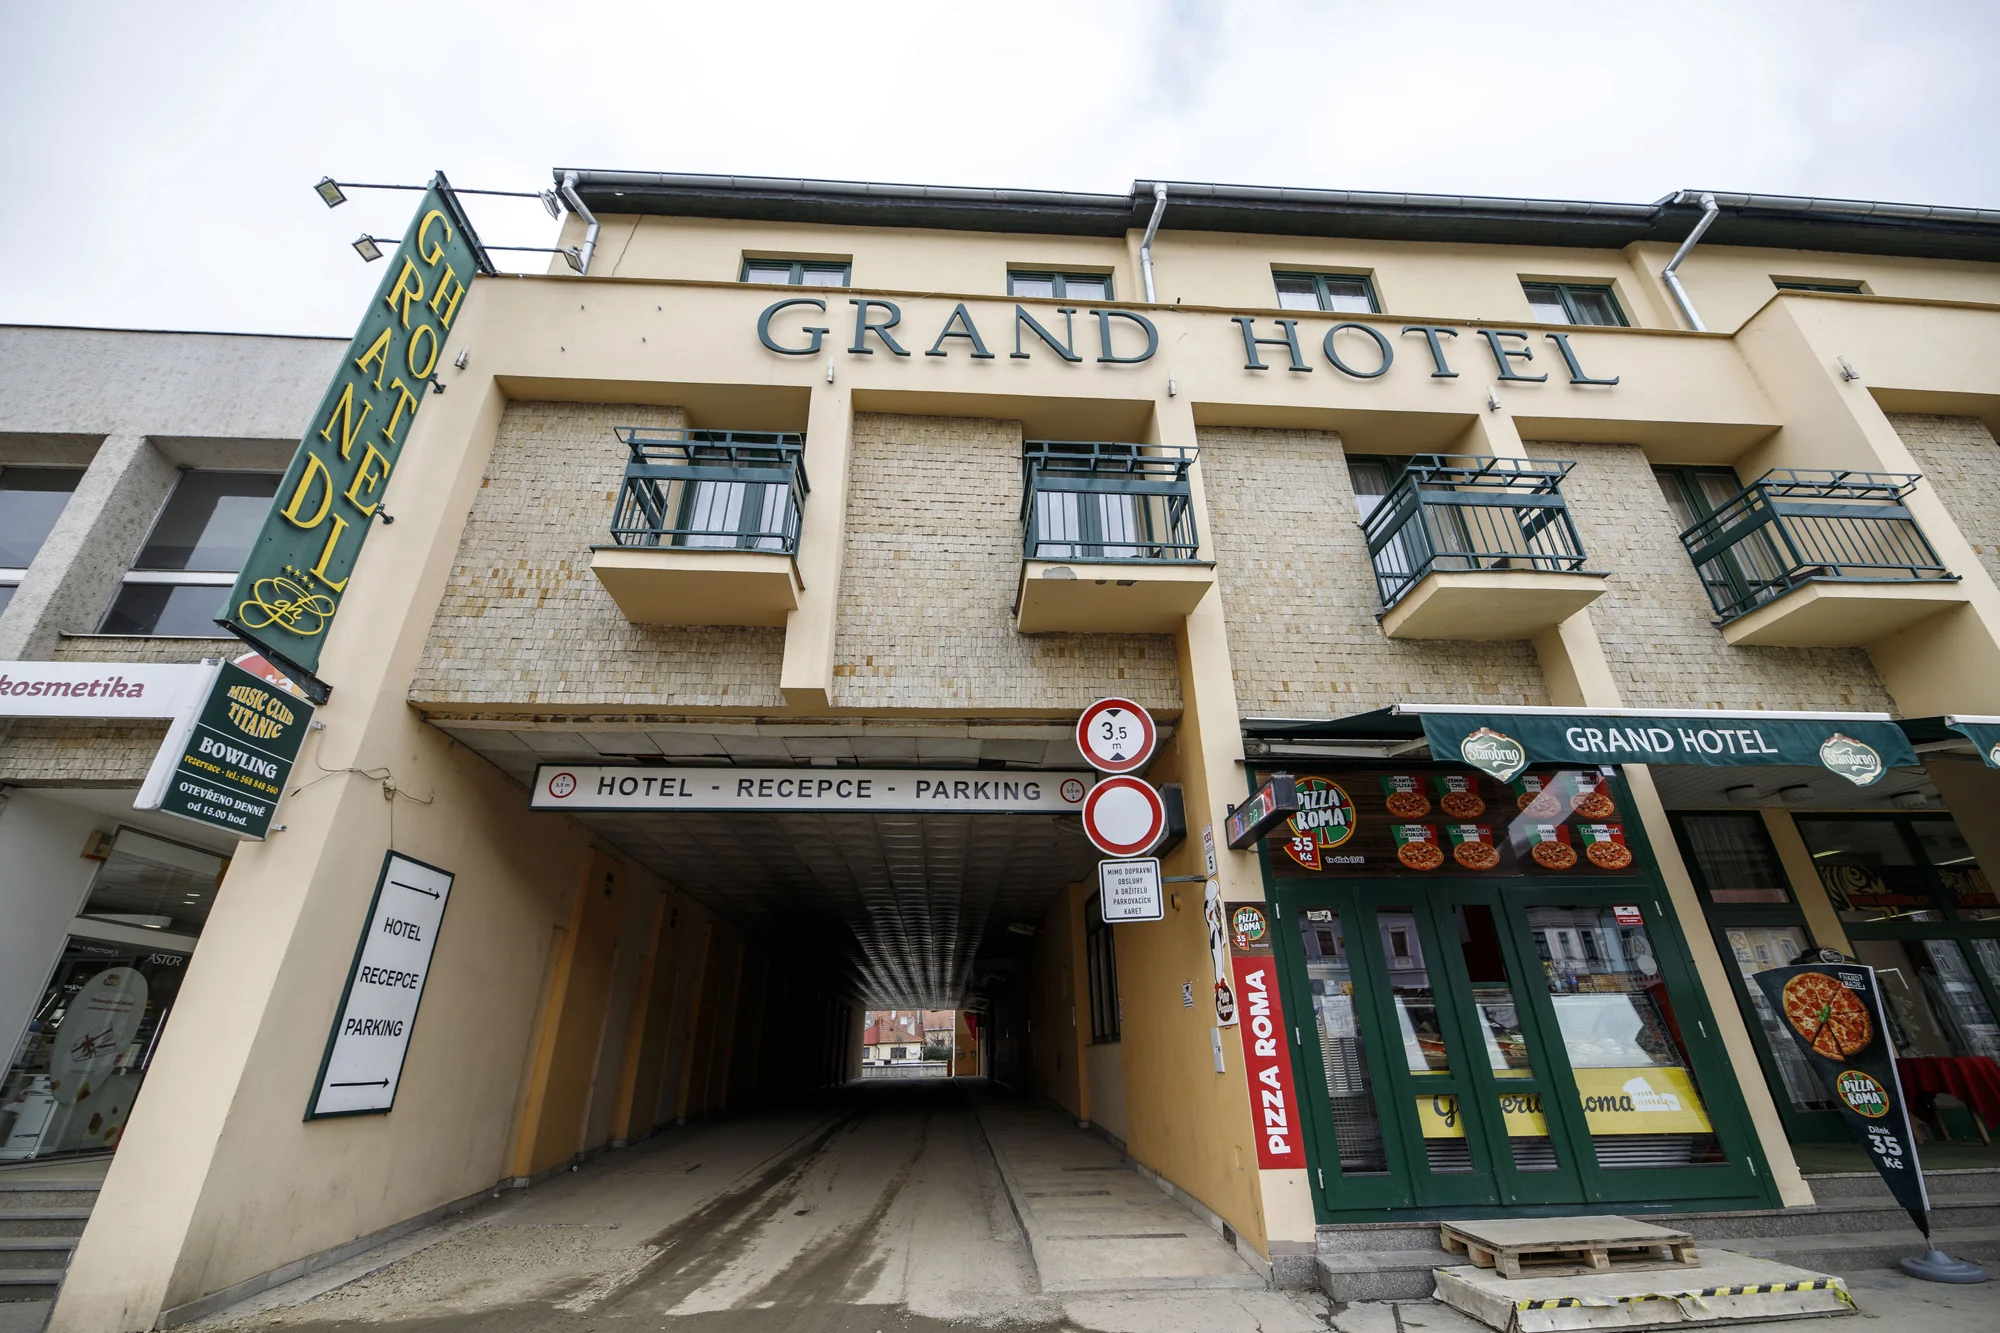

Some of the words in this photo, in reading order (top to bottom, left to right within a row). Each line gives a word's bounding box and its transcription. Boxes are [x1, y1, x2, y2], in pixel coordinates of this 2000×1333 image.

[757, 297, 1160, 364] GRAND
[1231, 317, 1620, 386] HOTEL
[281, 209, 454, 529] GRAND
[310, 262, 466, 593] HOTEL
[0, 674, 145, 698] kosmetika
[227, 686, 269, 711] MUSIC
[266, 698, 294, 726] CLUB
[228, 701, 284, 739] TITANIC
[1112, 742, 1122, 750] m
[1565, 727, 1674, 753] GRAND
[1681, 728, 1779, 754] HOTEL
[198, 736, 279, 779] BOWLING
[184, 754, 221, 774] rezervace
[240, 774, 253, 786] 568
[266, 784, 279, 795] 560
[179, 781, 233, 806] OTEVŘENO
[233, 799, 266, 817] DENNĚ
[597, 776, 693, 797] HOTEL
[737, 778, 872, 799] RECEPCE
[915, 780, 1041, 801] PARKING
[187, 801, 202, 812] od
[203, 805, 227, 819] 15.00
[227, 812, 248, 826] hod.
[1296, 808, 1346, 831] ROMA
[1292, 837, 1314, 851] 35
[1299, 852, 1313, 861] Kč
[1107, 868, 1123, 876] MIMO
[1124, 865, 1153, 875] DOPRAVNÍ
[1117, 877, 1143, 886] OBSLUHY
[1112, 896, 1152, 906] PARKOVACÍCH
[1123, 907, 1142, 915] KARET
[383, 917, 421, 942] HOTEL
[1236, 934, 1247, 942] 35
[1239, 921, 1260, 932] ROMA
[146, 952, 183, 967] ASTOR
[360, 965, 419, 989] RECEPCE
[1245, 969, 1277, 1057] ROMA
[344, 1018, 403, 1037] PARKING
[1259, 1065, 1291, 1155] PIZZA
[1582, 1094, 1634, 1113] oma
[1847, 1092, 1882, 1105] ROMA
[1868, 1134, 1903, 1156] 35
[1883, 1156, 1904, 1170] Kč
